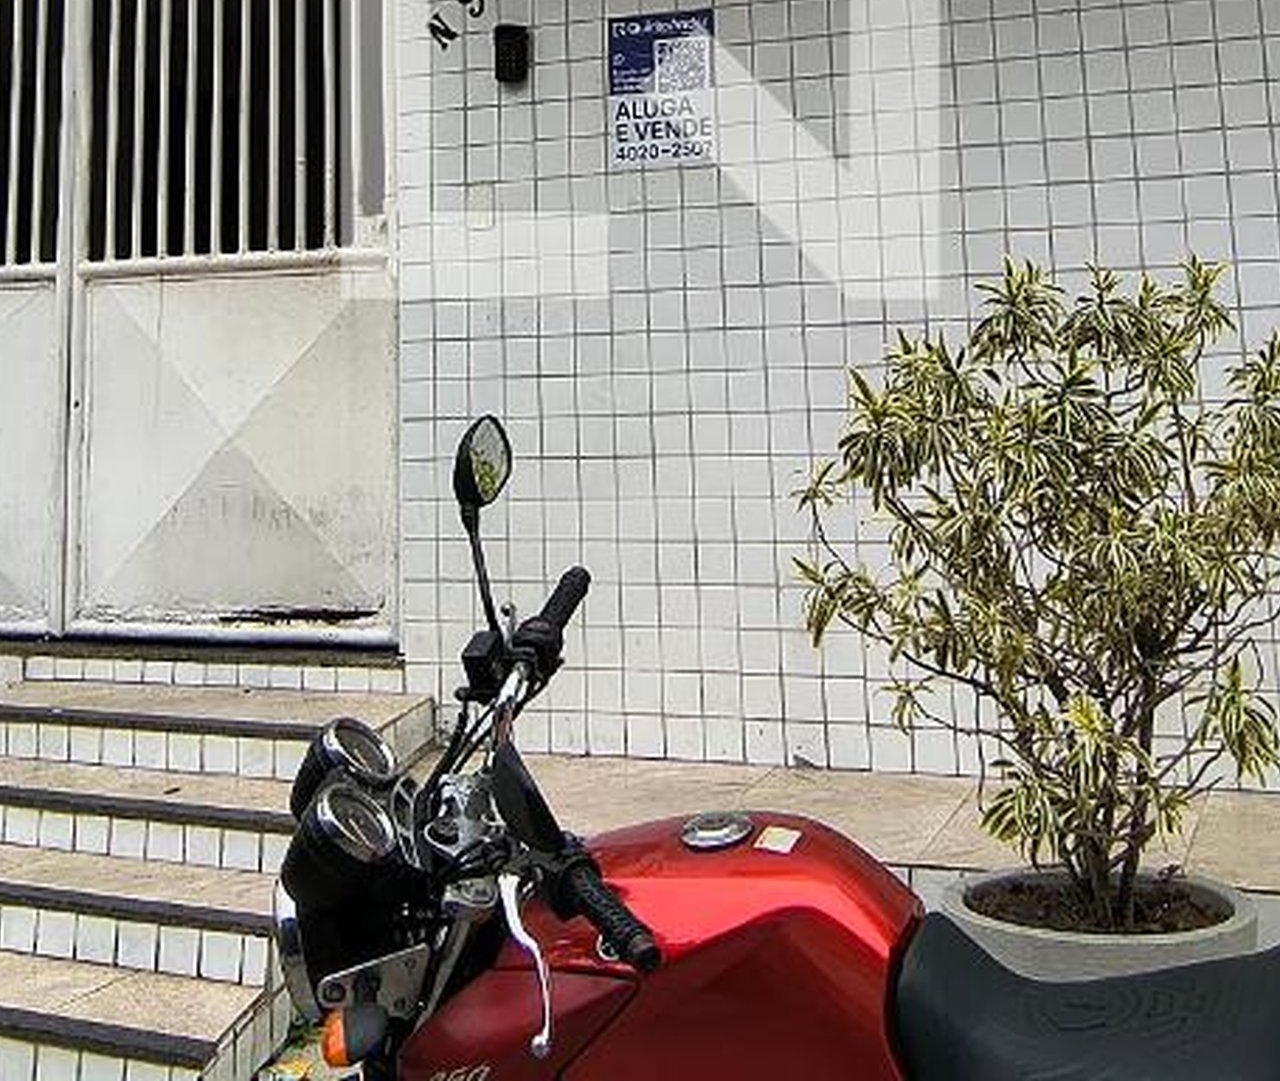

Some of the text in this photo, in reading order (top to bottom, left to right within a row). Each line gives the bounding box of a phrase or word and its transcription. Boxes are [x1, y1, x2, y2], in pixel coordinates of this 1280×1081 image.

[616, 98, 694, 120] ALUGA
[616, 118, 712, 142] E VENDE
